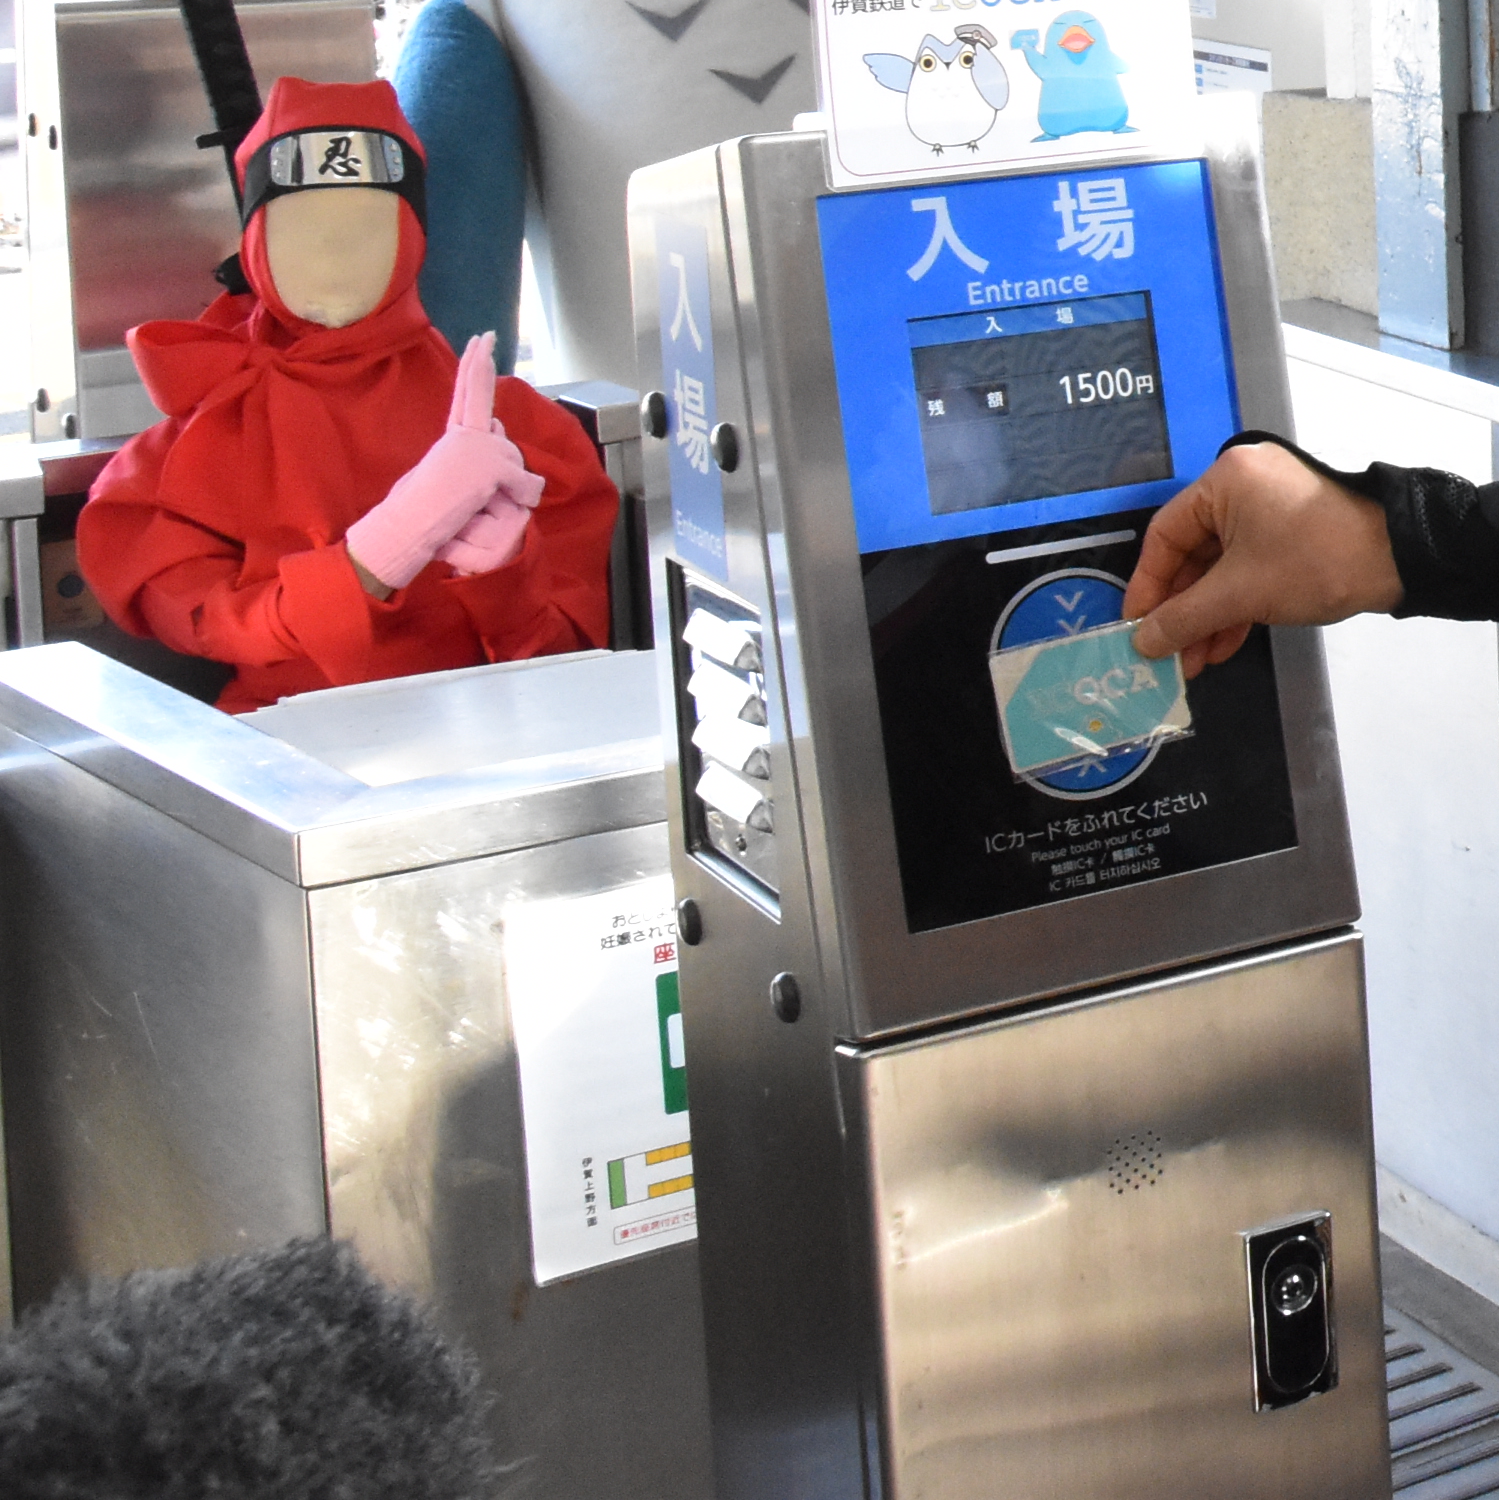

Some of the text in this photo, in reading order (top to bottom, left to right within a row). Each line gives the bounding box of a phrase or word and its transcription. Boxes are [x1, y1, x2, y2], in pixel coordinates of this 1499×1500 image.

[318, 136, 361, 177] 忍
[907, 178, 1135, 283] 入場
[967, 273, 1089, 307] Entrance
[984, 306, 1074, 335] 入場
[669, 252, 709, 475] 入場
[927, 366, 1155, 418] 残額 1500円
[674, 509, 725, 560] Entrance
[985, 791, 1209, 854] ICカードをふれてください
[1031, 823, 1171, 863] Please touch your IC card
[1049, 879, 1061, 892] IC
